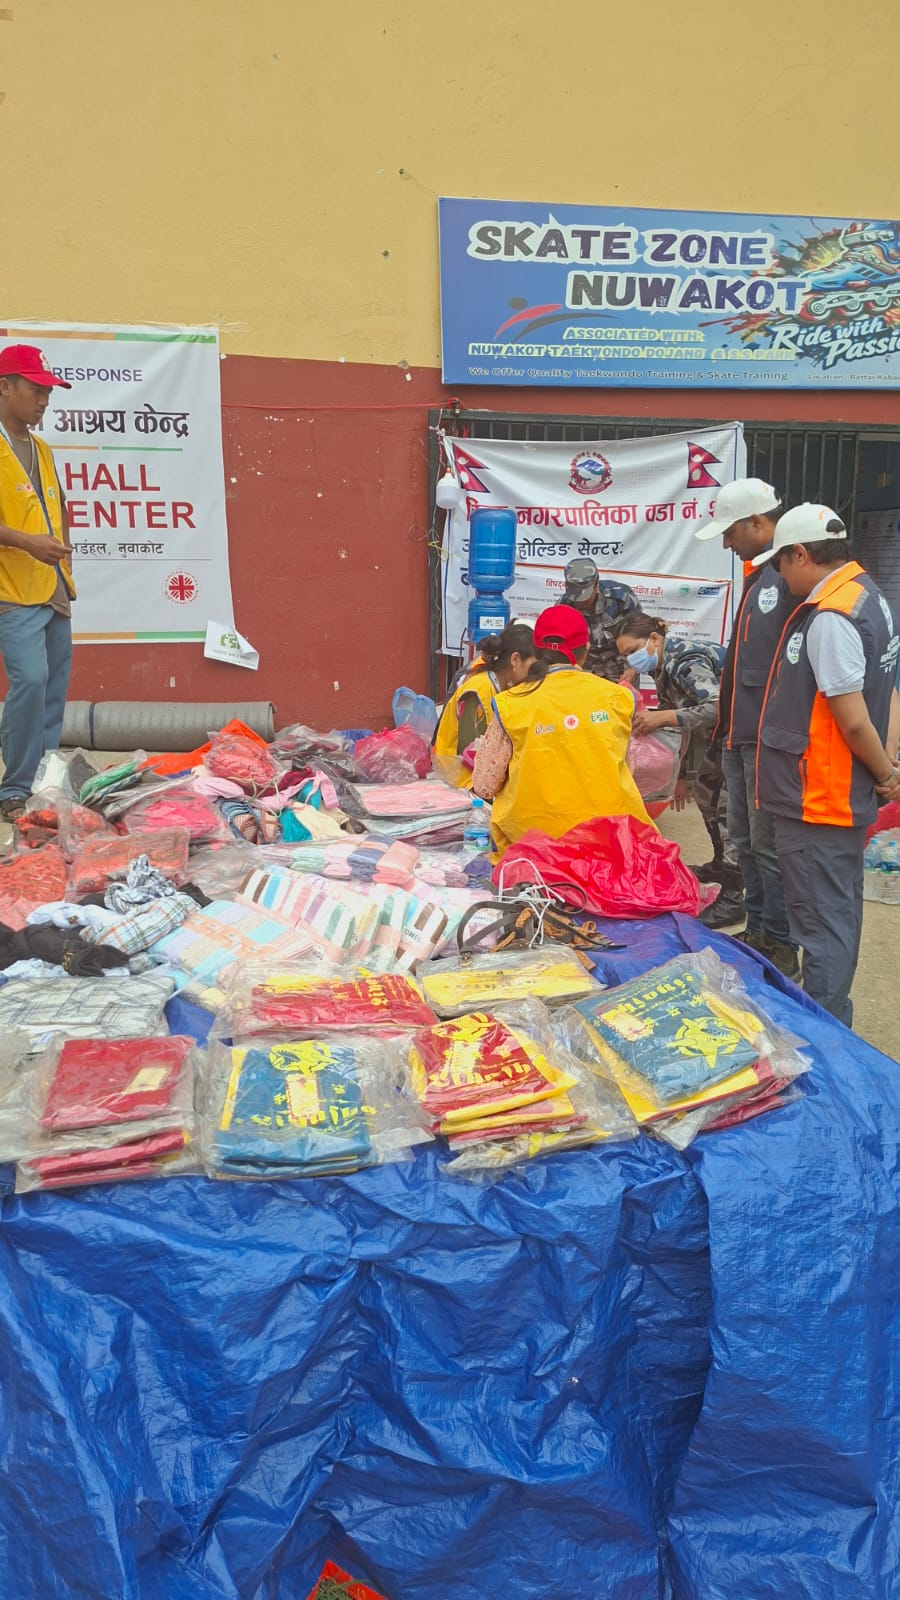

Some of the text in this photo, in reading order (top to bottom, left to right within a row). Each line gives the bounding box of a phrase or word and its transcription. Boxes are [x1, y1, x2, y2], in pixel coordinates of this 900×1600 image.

[472, 222, 769, 265] SKATE ZONE
[569, 273, 811, 314] NUWAKOT
[565, 328, 657, 341] ASSOCIATED
[771, 315, 888, 352] Ride with
[470, 344, 545, 357] NUWAKOT
[550, 346, 641, 359] TAEKWONDO
[645, 348, 704, 360] DOJANG
[52, 367, 143, 382] RESPONSE
[469, 367, 788, 381] We Offer Quality Taekwondo Training & Skate Training
[53, 408, 126, 434] आश्रय
[134, 403, 190, 437] केन्द्र
[64, 462, 161, 492] HALL
[66, 500, 197, 529] ENTER
[514, 500, 639, 527] नगरपालिका
[645, 503, 676, 522] वडा
